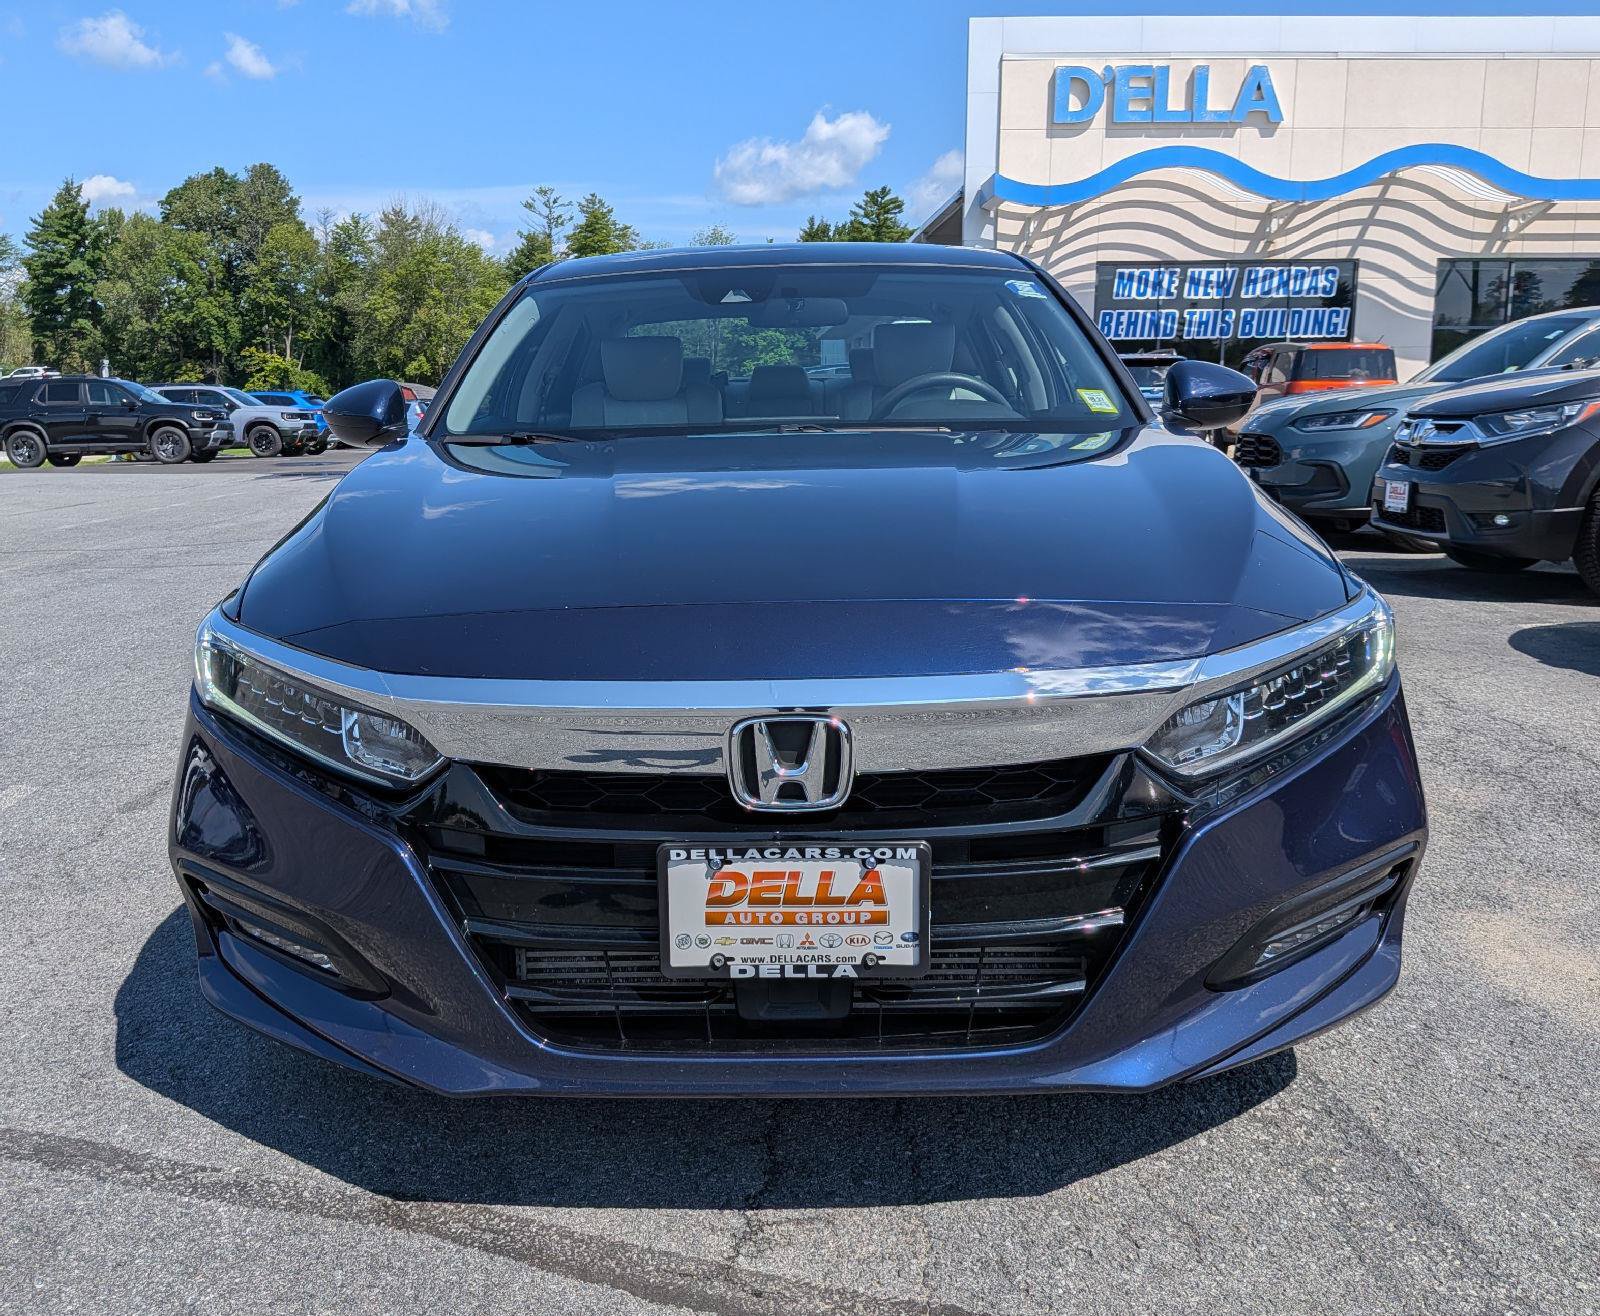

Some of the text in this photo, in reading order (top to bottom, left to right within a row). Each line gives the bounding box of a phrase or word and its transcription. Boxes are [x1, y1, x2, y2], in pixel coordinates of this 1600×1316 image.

[1053, 65, 1284, 123] D'ELLA
[1113, 266, 1339, 300] MORE NEW HONDAS
[1099, 307, 1350, 340] BEHIND THIS BUILDING!
[669, 847, 917, 860] DELLACARS.COM
[705, 870, 888, 908] DELLA
[724, 912, 872, 924] AUTO GROUP
[849, 936, 867, 945] KIA
[740, 954, 857, 964] www.DELLACARS.com
[730, 964, 859, 978] DELLA
